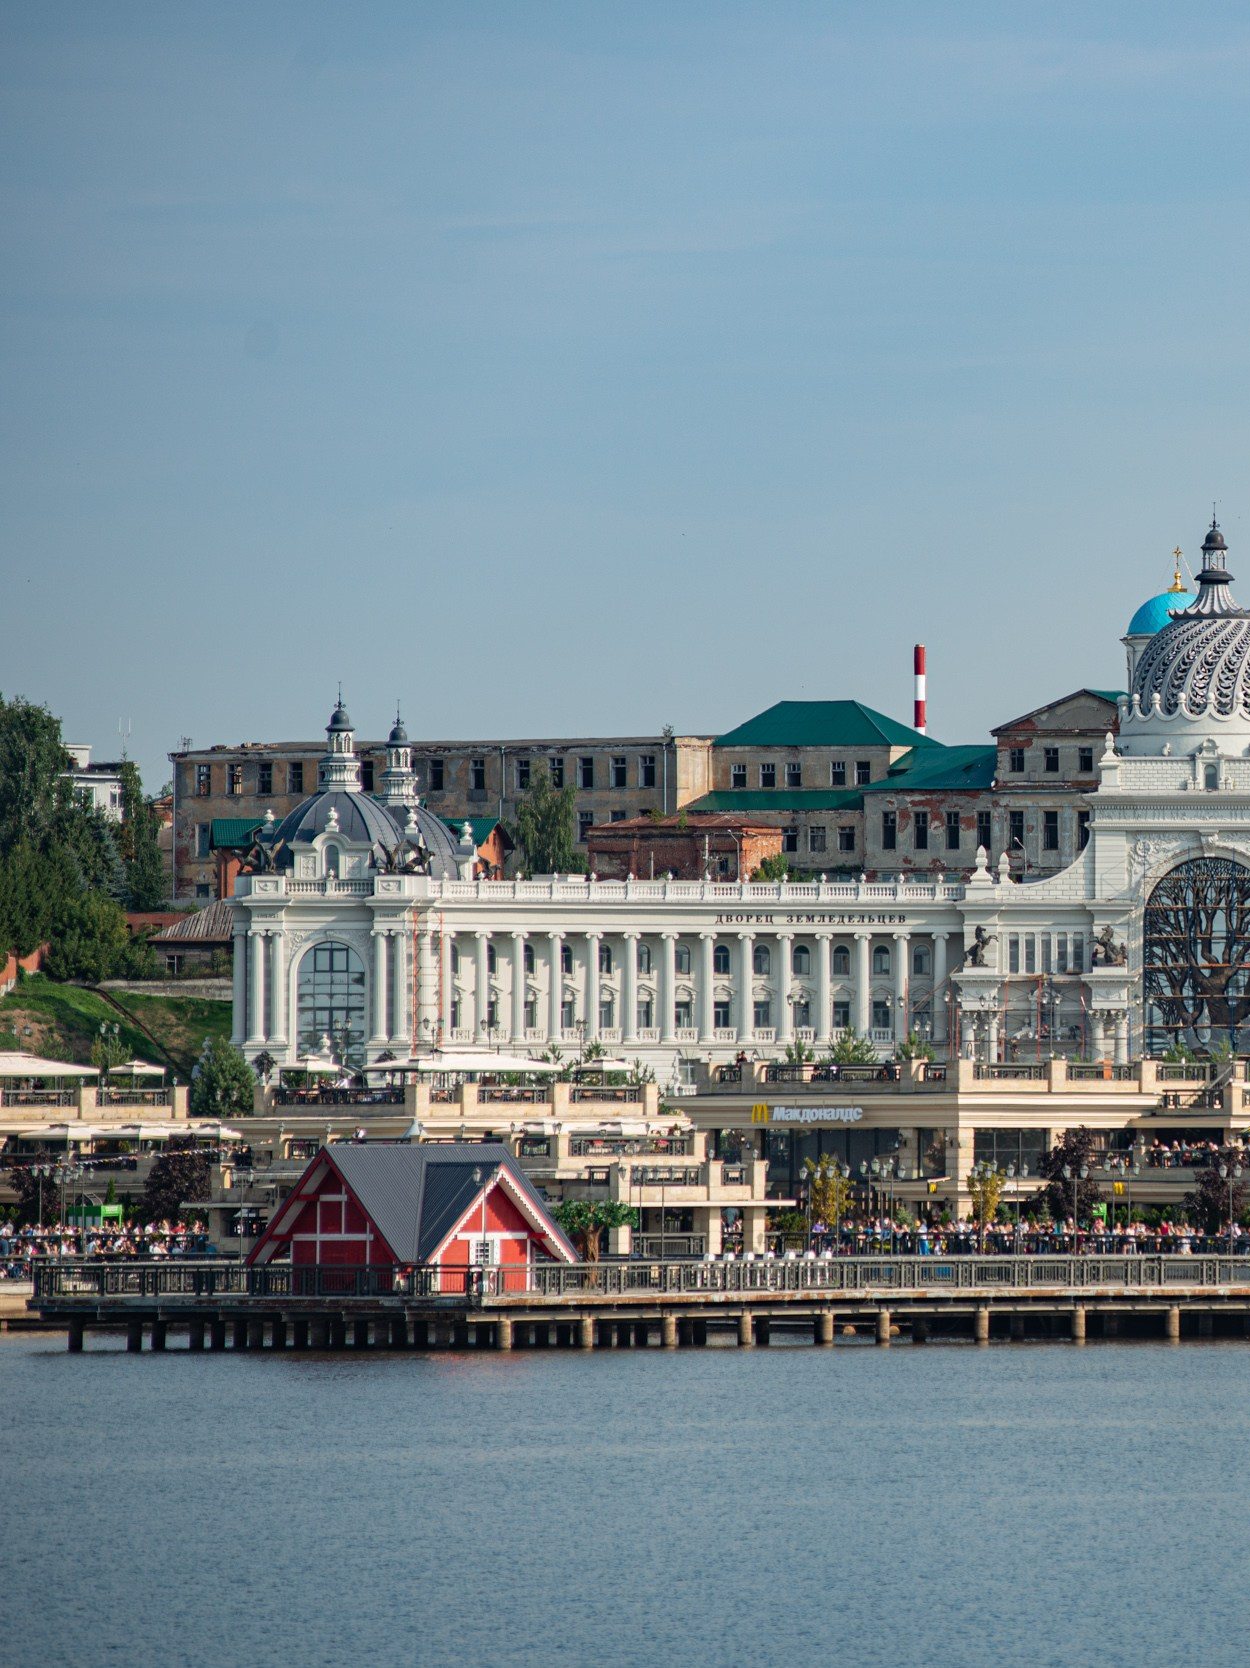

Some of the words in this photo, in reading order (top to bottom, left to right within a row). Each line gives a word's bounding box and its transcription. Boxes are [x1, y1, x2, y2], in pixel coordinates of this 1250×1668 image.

[715, 914, 774, 924] ДВОРЕЦ
[786, 914, 907, 924] ЗЕМЛЕДЕЛЬЦЕВ
[772, 1106, 862, 1123] Макдоналдс
